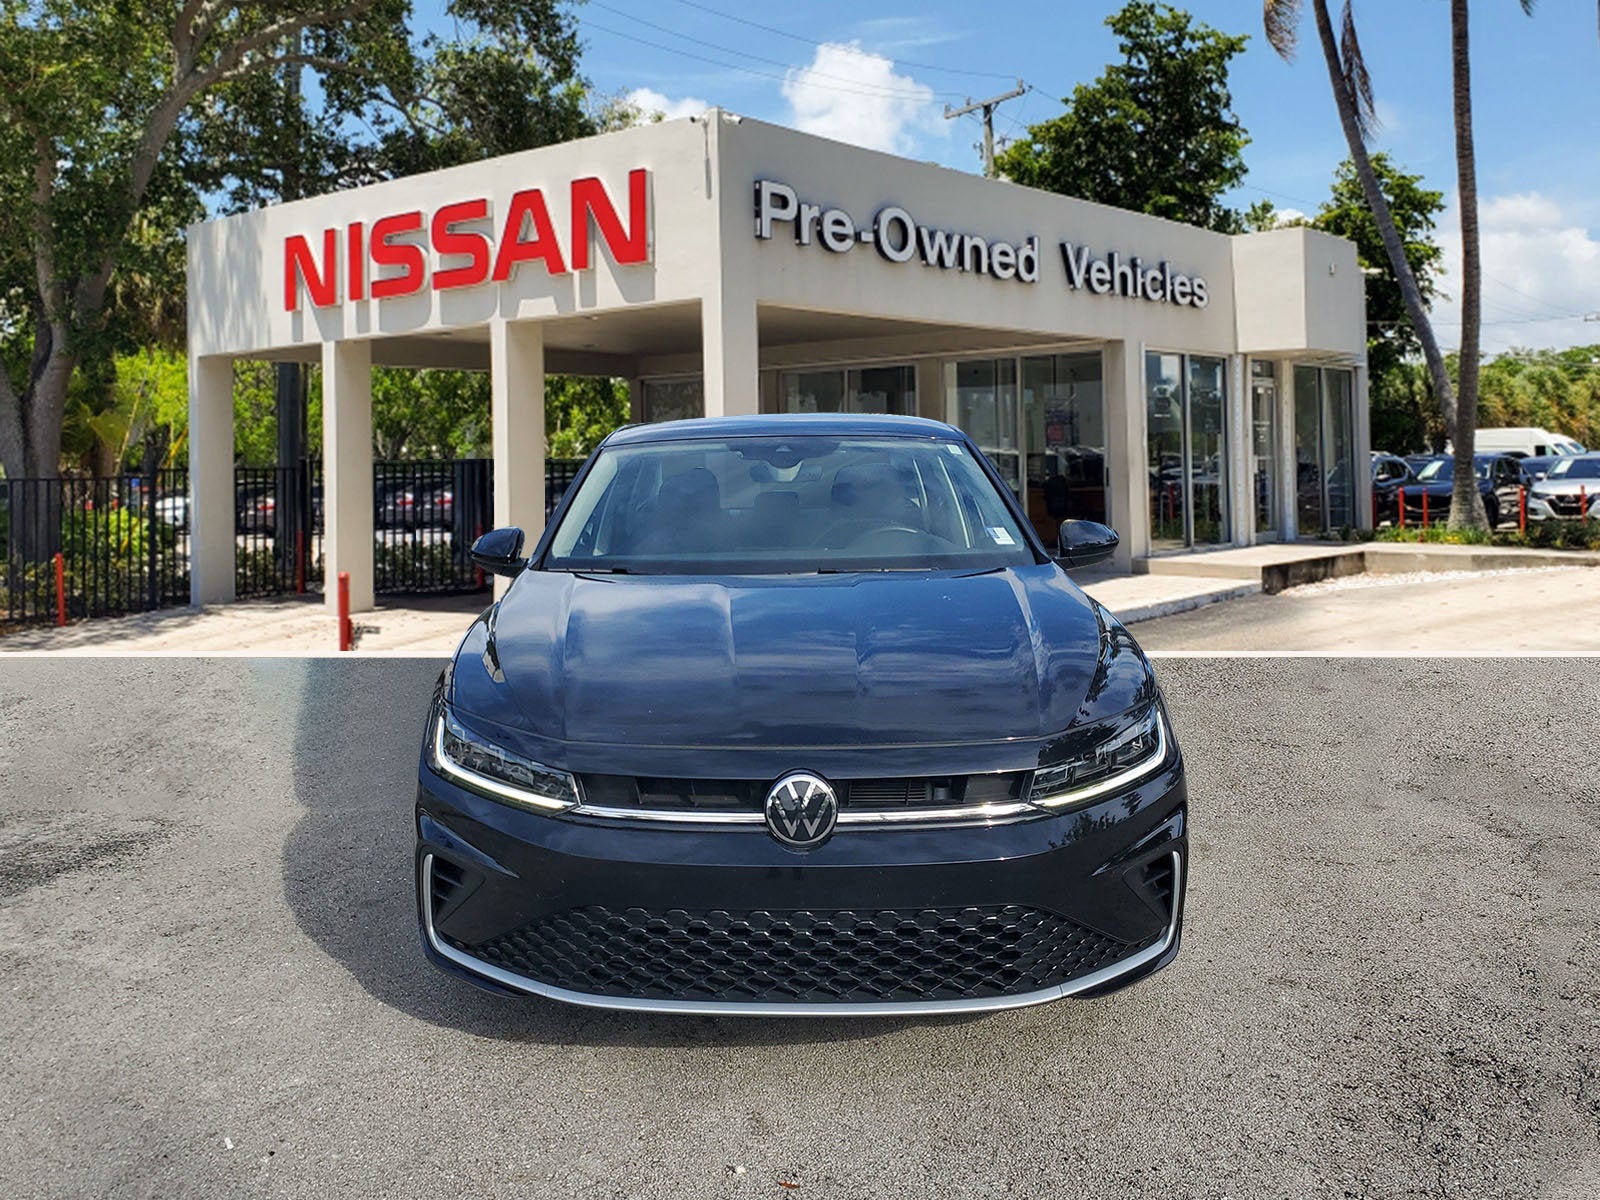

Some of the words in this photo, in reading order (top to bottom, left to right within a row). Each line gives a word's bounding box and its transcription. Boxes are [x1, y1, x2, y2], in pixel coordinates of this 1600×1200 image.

[285, 168, 648, 311] NISSAN
[755, 180, 1039, 283] Pre-Owned
[1062, 240, 1208, 308] Vehicles
